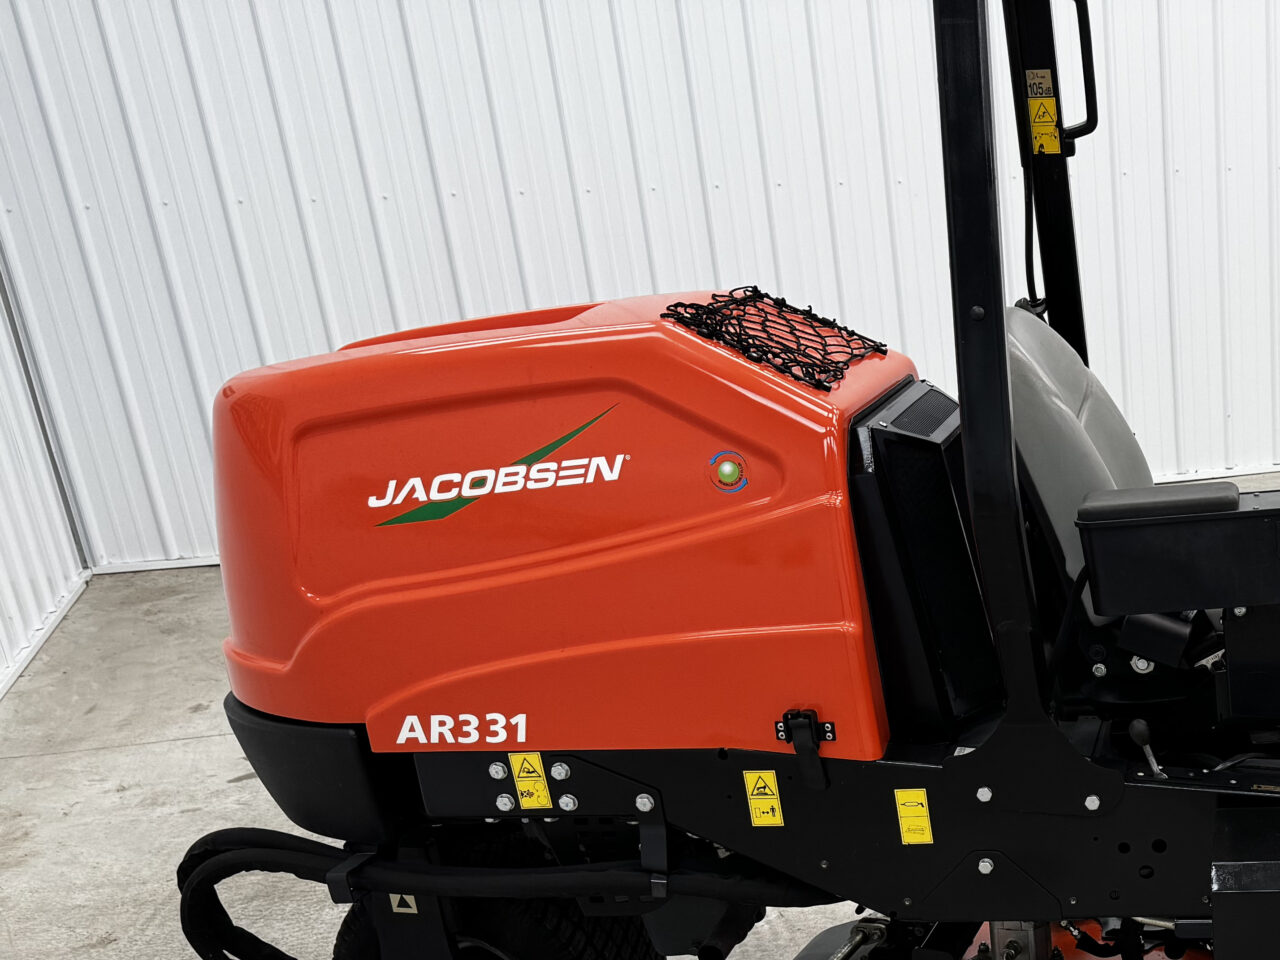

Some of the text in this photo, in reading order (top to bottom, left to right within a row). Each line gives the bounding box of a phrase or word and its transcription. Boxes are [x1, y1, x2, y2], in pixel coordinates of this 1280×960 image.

[1028, 82, 1053, 96] 105 dB
[367, 454, 625, 508] JACOBSEN
[396, 713, 527, 744] AR331
